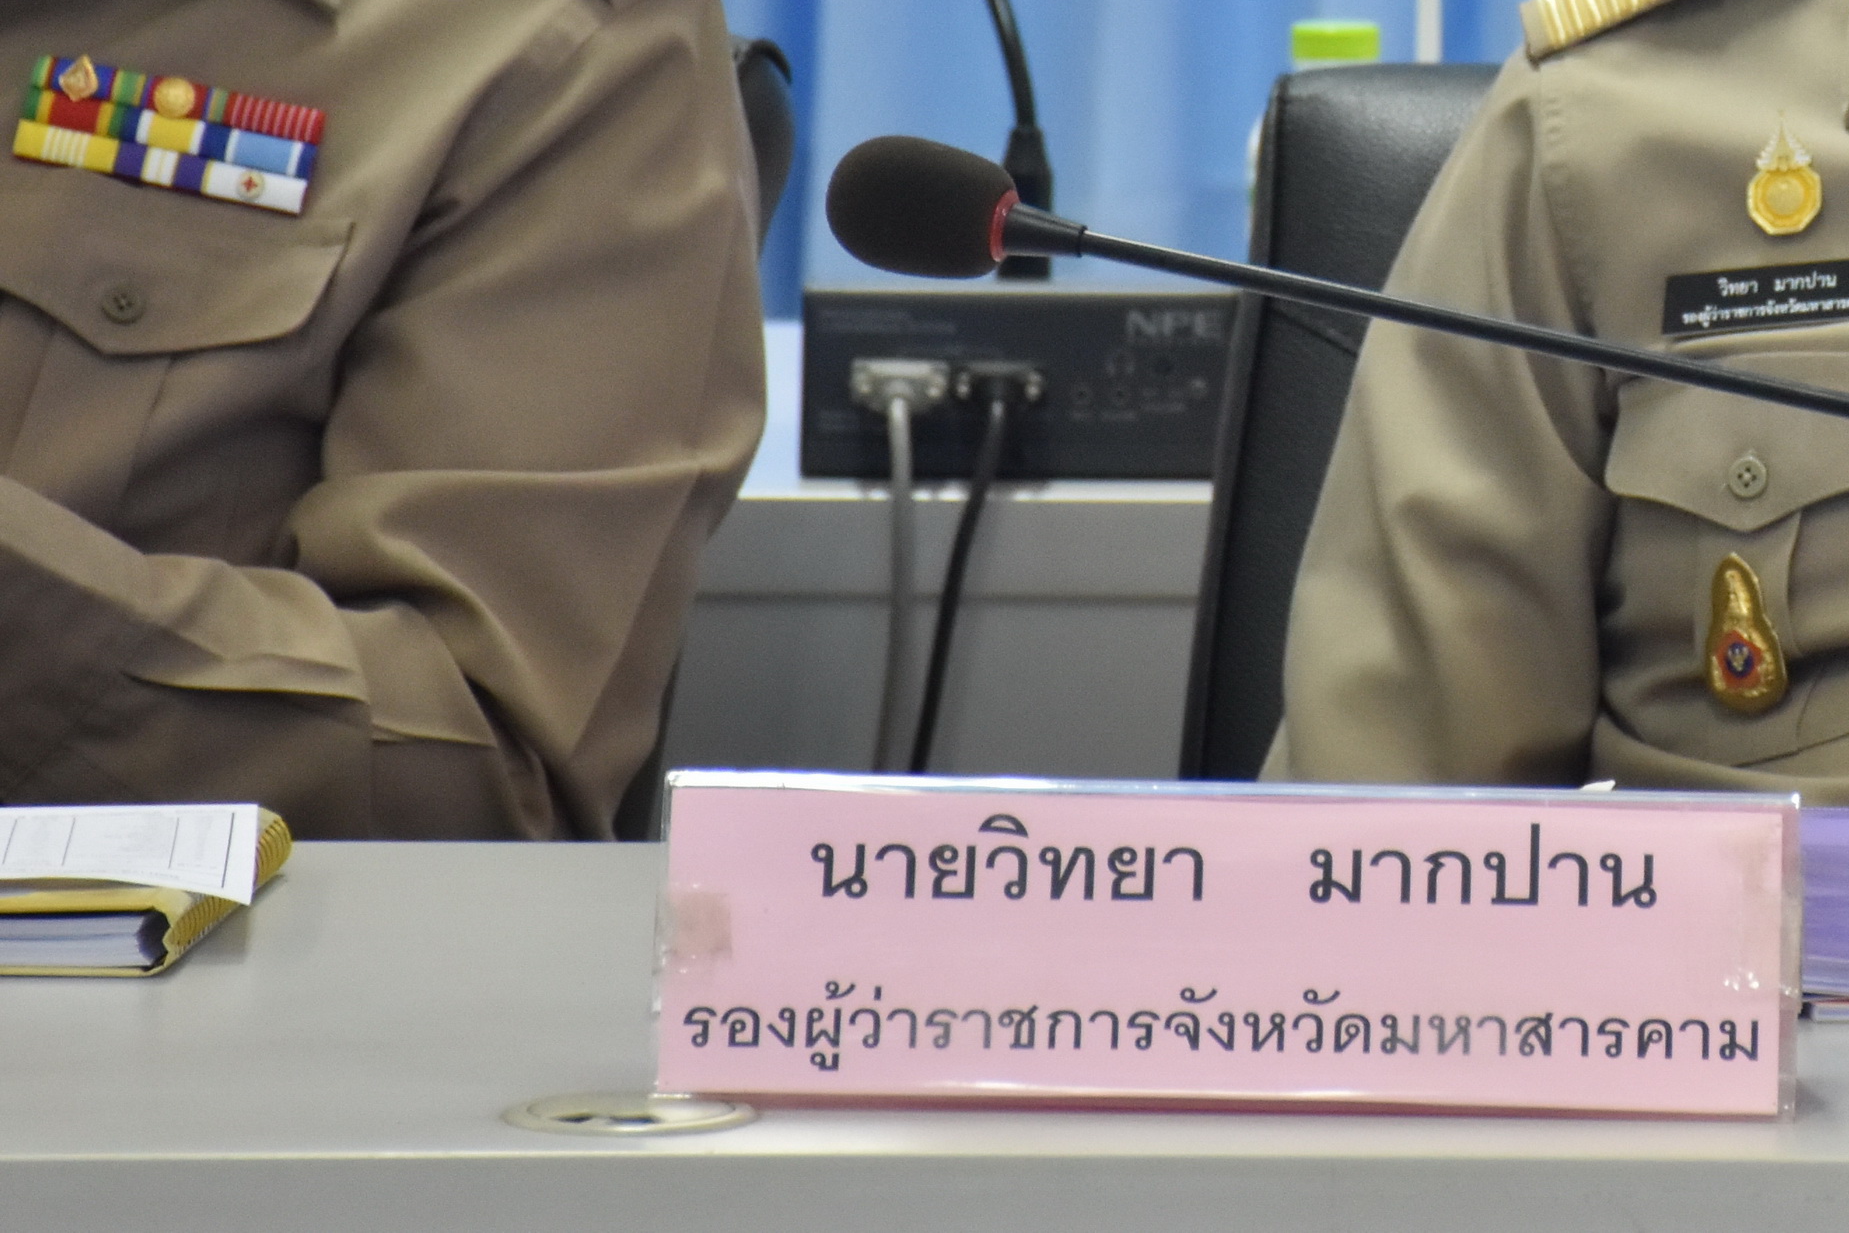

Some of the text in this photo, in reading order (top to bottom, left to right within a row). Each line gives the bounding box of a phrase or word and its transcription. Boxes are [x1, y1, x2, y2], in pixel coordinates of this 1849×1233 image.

[1717, 270, 1838, 297] วิทยา มากปาน
[810, 814, 1657, 909] นายวิทยา มากปาน
[683, 980, 1759, 1071] รองผู้ว่าราชการจังหวัดมหาสารคาม
